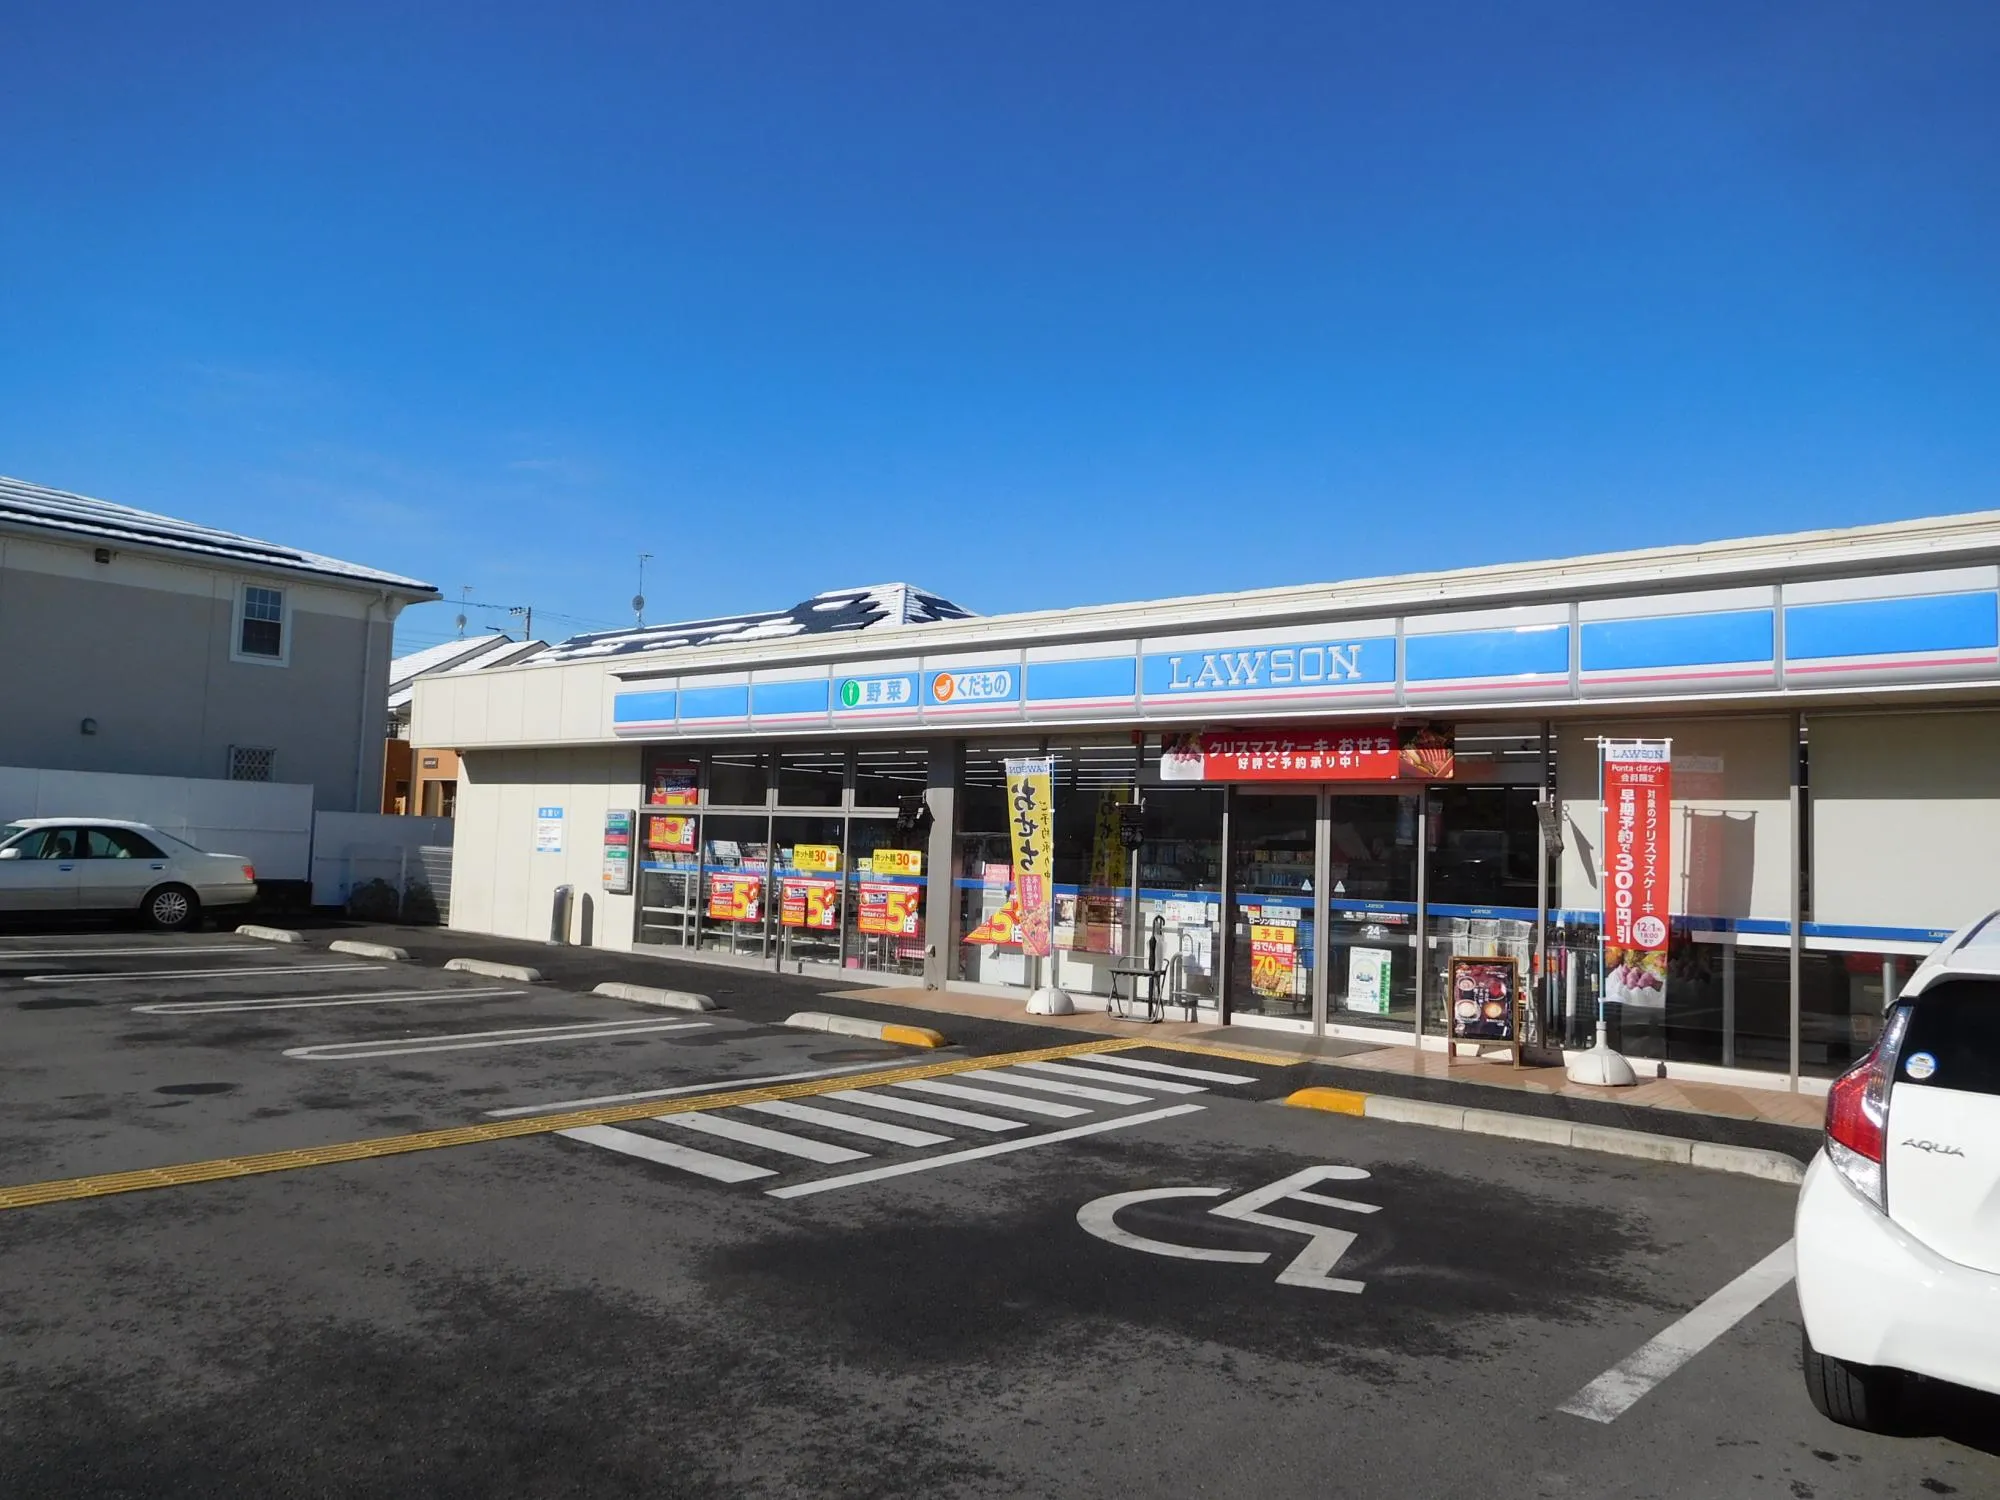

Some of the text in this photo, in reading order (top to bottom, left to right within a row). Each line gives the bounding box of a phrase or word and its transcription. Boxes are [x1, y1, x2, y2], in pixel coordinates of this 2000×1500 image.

[1169, 644, 1362, 689] LAWSON
[866, 681, 902, 702] 野菜
[957, 674, 1007, 697] くだもの
[1208, 737, 1391, 758] クリスマスケーキ・おせち
[1613, 749, 1664, 759] LAWSON
[1620, 773, 1656, 783] 会員限定
[1641, 789, 1657, 914] 対象のクリスマスケーキ
[1261, 928, 1285, 941] 予告
[1367, 925, 1381, 936] 24
[1901, 1137, 1965, 1157] AQUA
